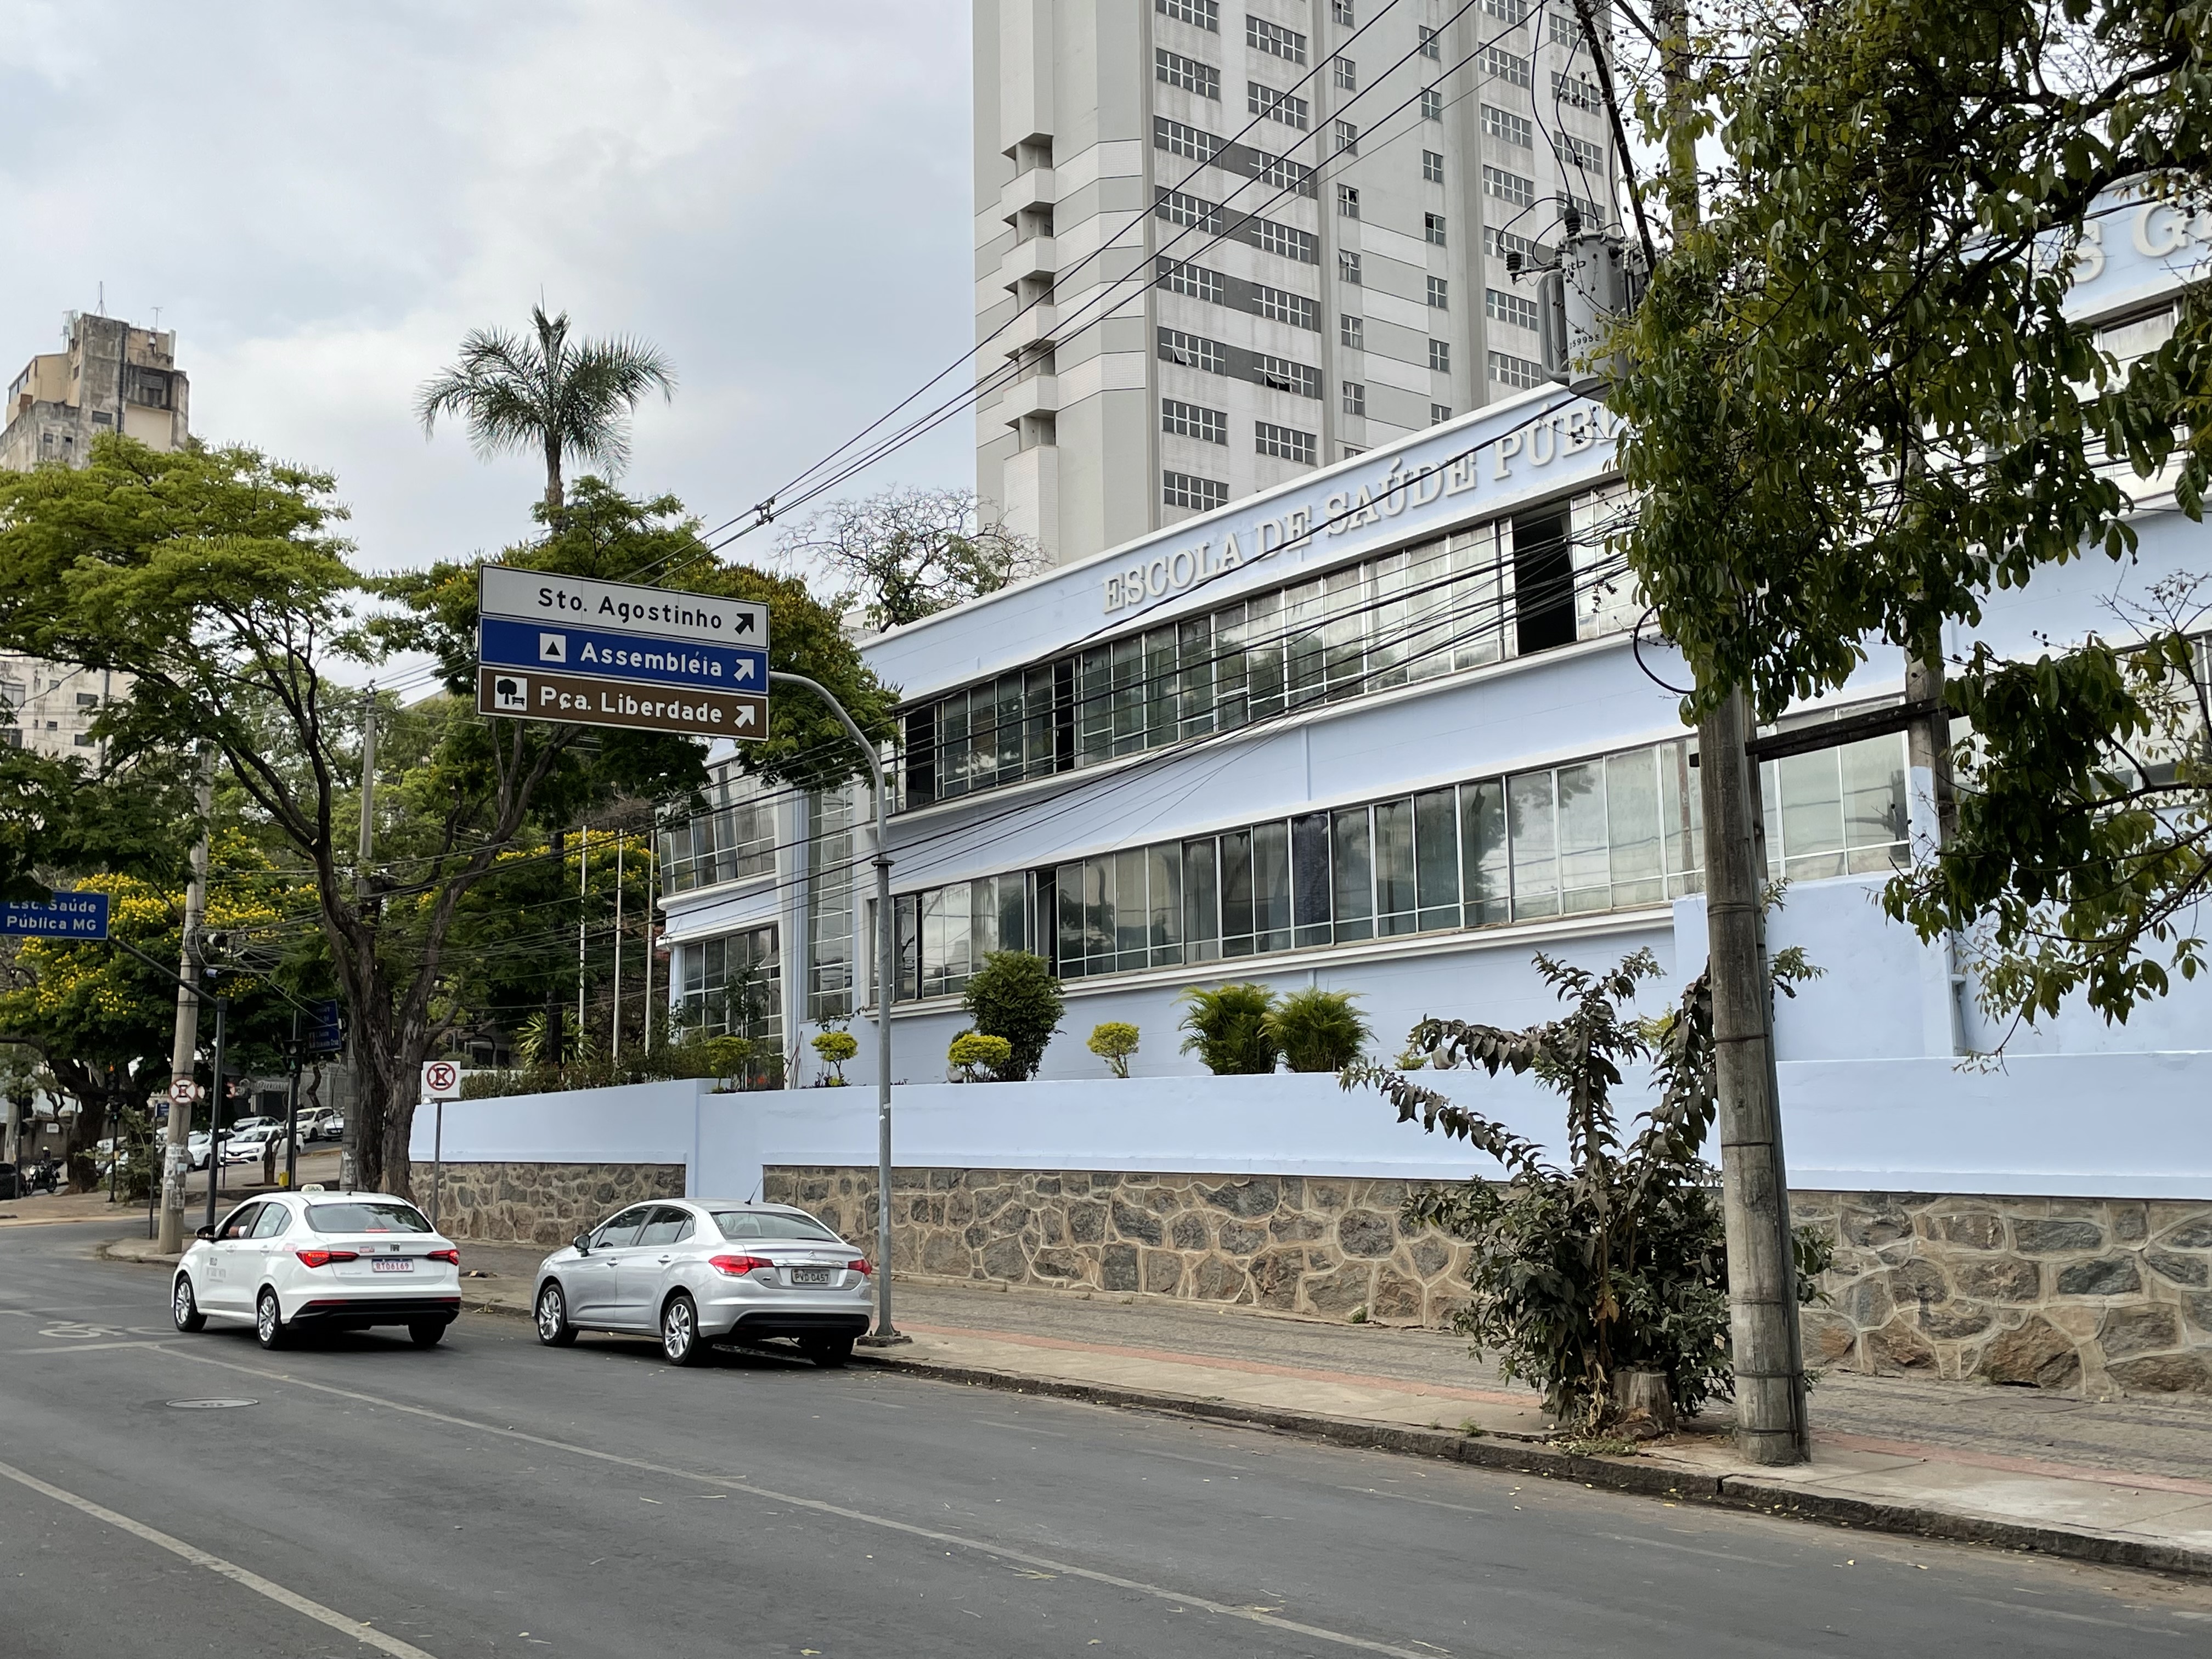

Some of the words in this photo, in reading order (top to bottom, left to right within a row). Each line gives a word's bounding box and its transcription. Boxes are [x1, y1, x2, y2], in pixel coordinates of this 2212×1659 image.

[1103, 532, 1245, 613] ESCOLA
[1256, 505, 1312, 562] DE
[1324, 450, 1478, 537] SAÚDE
[538, 588, 588, 612] Sto.
[598, 595, 723, 629] Agostinho
[579, 641, 723, 677] Assembléia
[540, 686, 592, 710] Pça.
[600, 692, 723, 723] Liberdade
[7, 913, 67, 929] Pública
[72, 918, 97, 931] MG
[48, 898, 96, 912] Saúde
